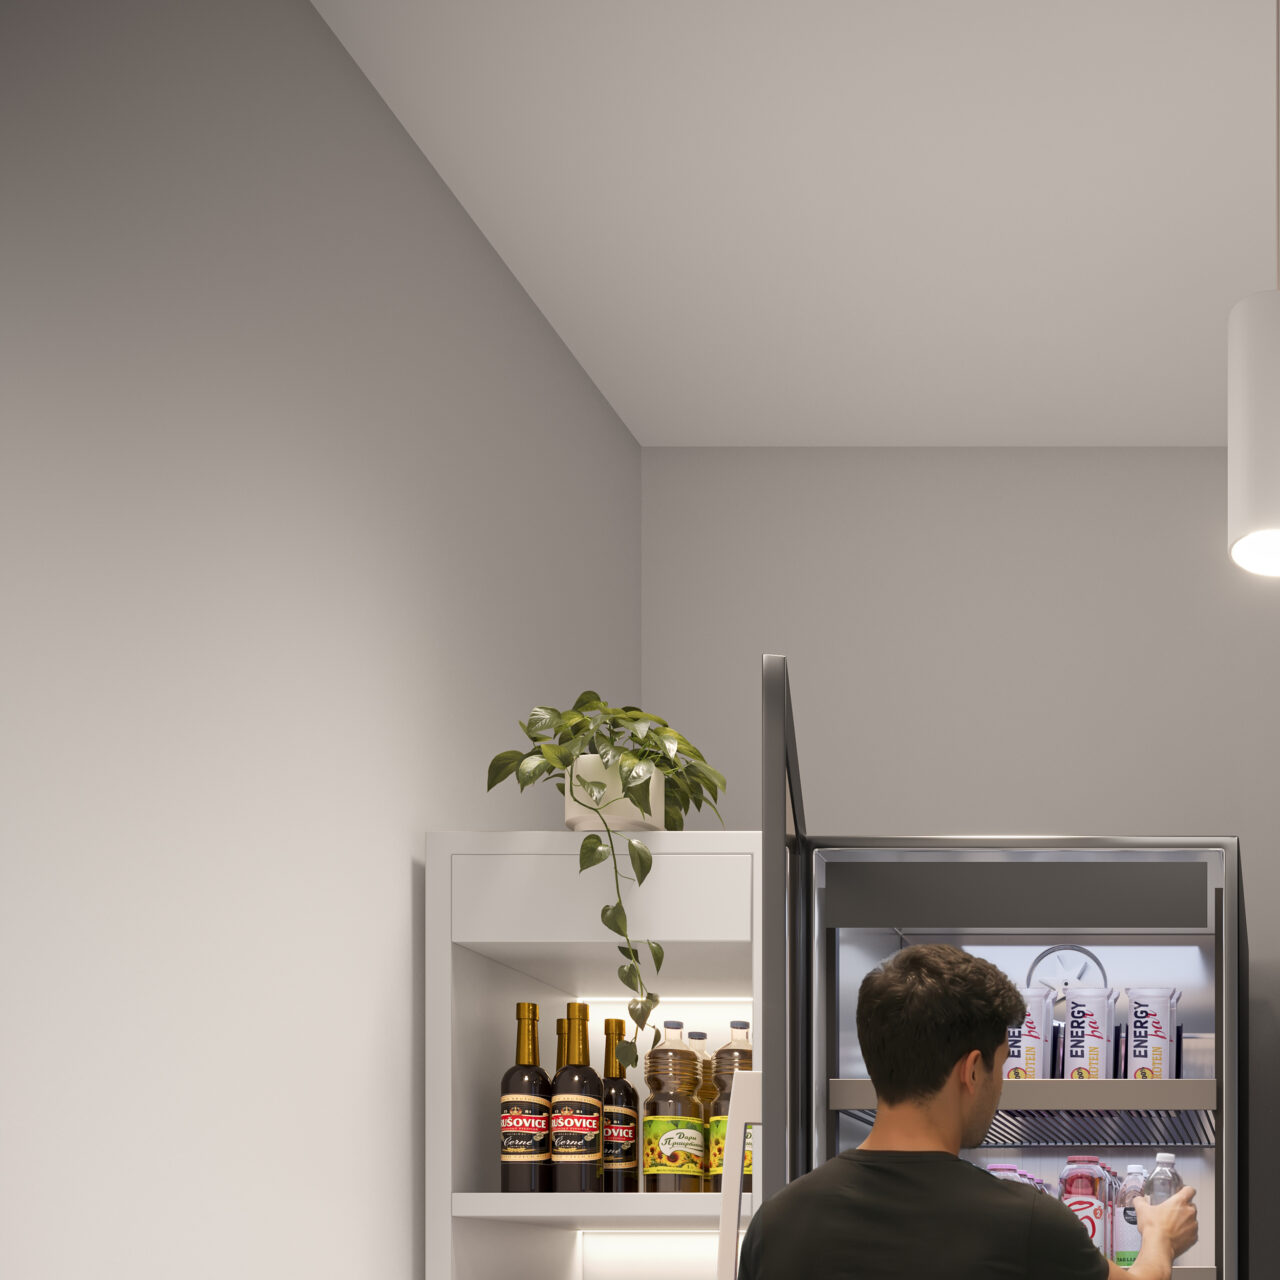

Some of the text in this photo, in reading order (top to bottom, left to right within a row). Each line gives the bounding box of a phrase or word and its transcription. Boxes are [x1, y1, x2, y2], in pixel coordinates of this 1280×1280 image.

[1070, 1001, 1086, 1058] ENERGY
[1082, 1010, 1104, 1040] bar
[1133, 1001, 1149, 1058] ENERGY
[1146, 1010, 1168, 1040] bar
